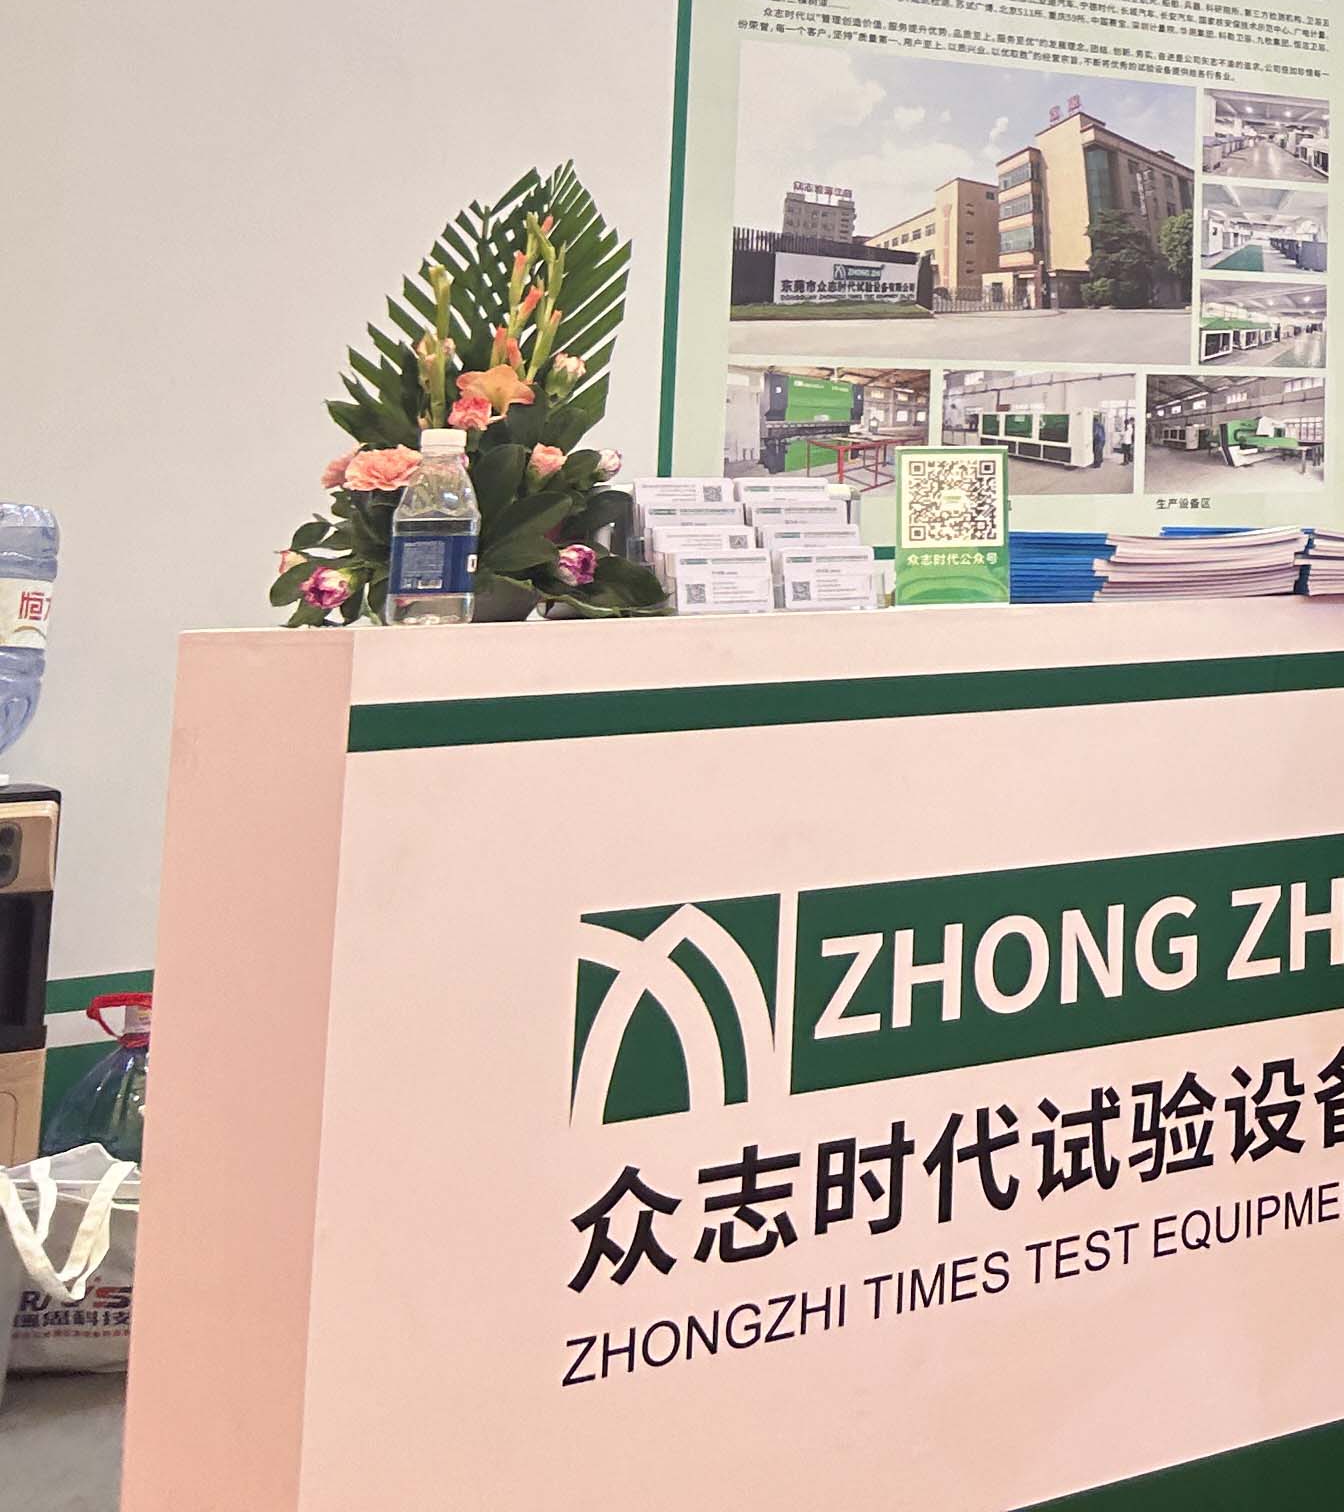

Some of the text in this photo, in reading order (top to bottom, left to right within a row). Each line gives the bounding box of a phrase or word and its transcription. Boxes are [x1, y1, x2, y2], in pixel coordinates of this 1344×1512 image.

[907, 552, 998, 566] 众志时代公众号
[812, 895, 1198, 1040] ZHONG
[562, 1282, 846, 1387] ZHONGZHI
[863, 1249, 1010, 1319] TIMES
[1025, 1223, 1141, 1285] TEST
